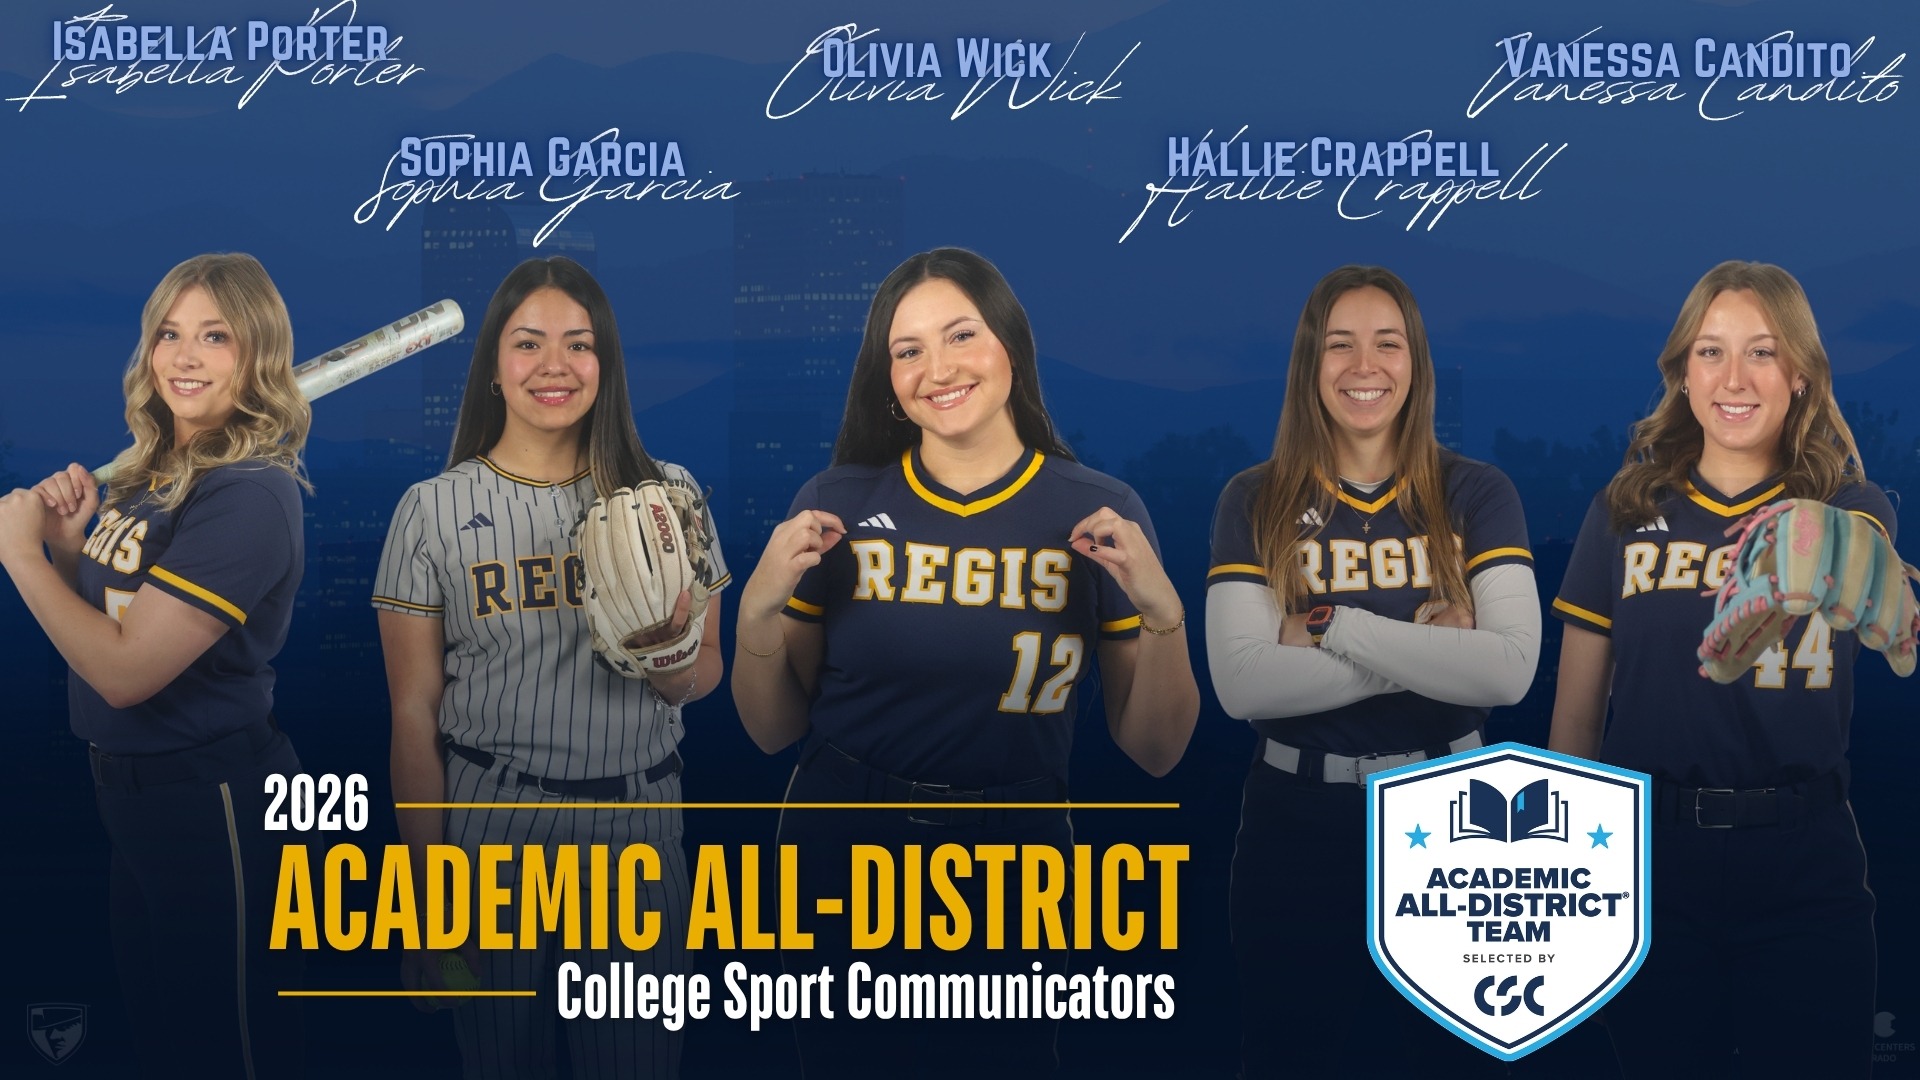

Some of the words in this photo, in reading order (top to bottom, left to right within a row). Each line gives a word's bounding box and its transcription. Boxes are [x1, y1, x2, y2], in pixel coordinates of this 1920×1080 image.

[82, 508, 148, 574] EGIS
[649, 503, 675, 553] A2000
[850, 539, 1072, 612] REGIS
[1296, 533, 1463, 594] REGI
[1622, 541, 1737, 599] REG
[652, 639, 698, 668] Wilson
[997, 631, 1084, 714] 12
